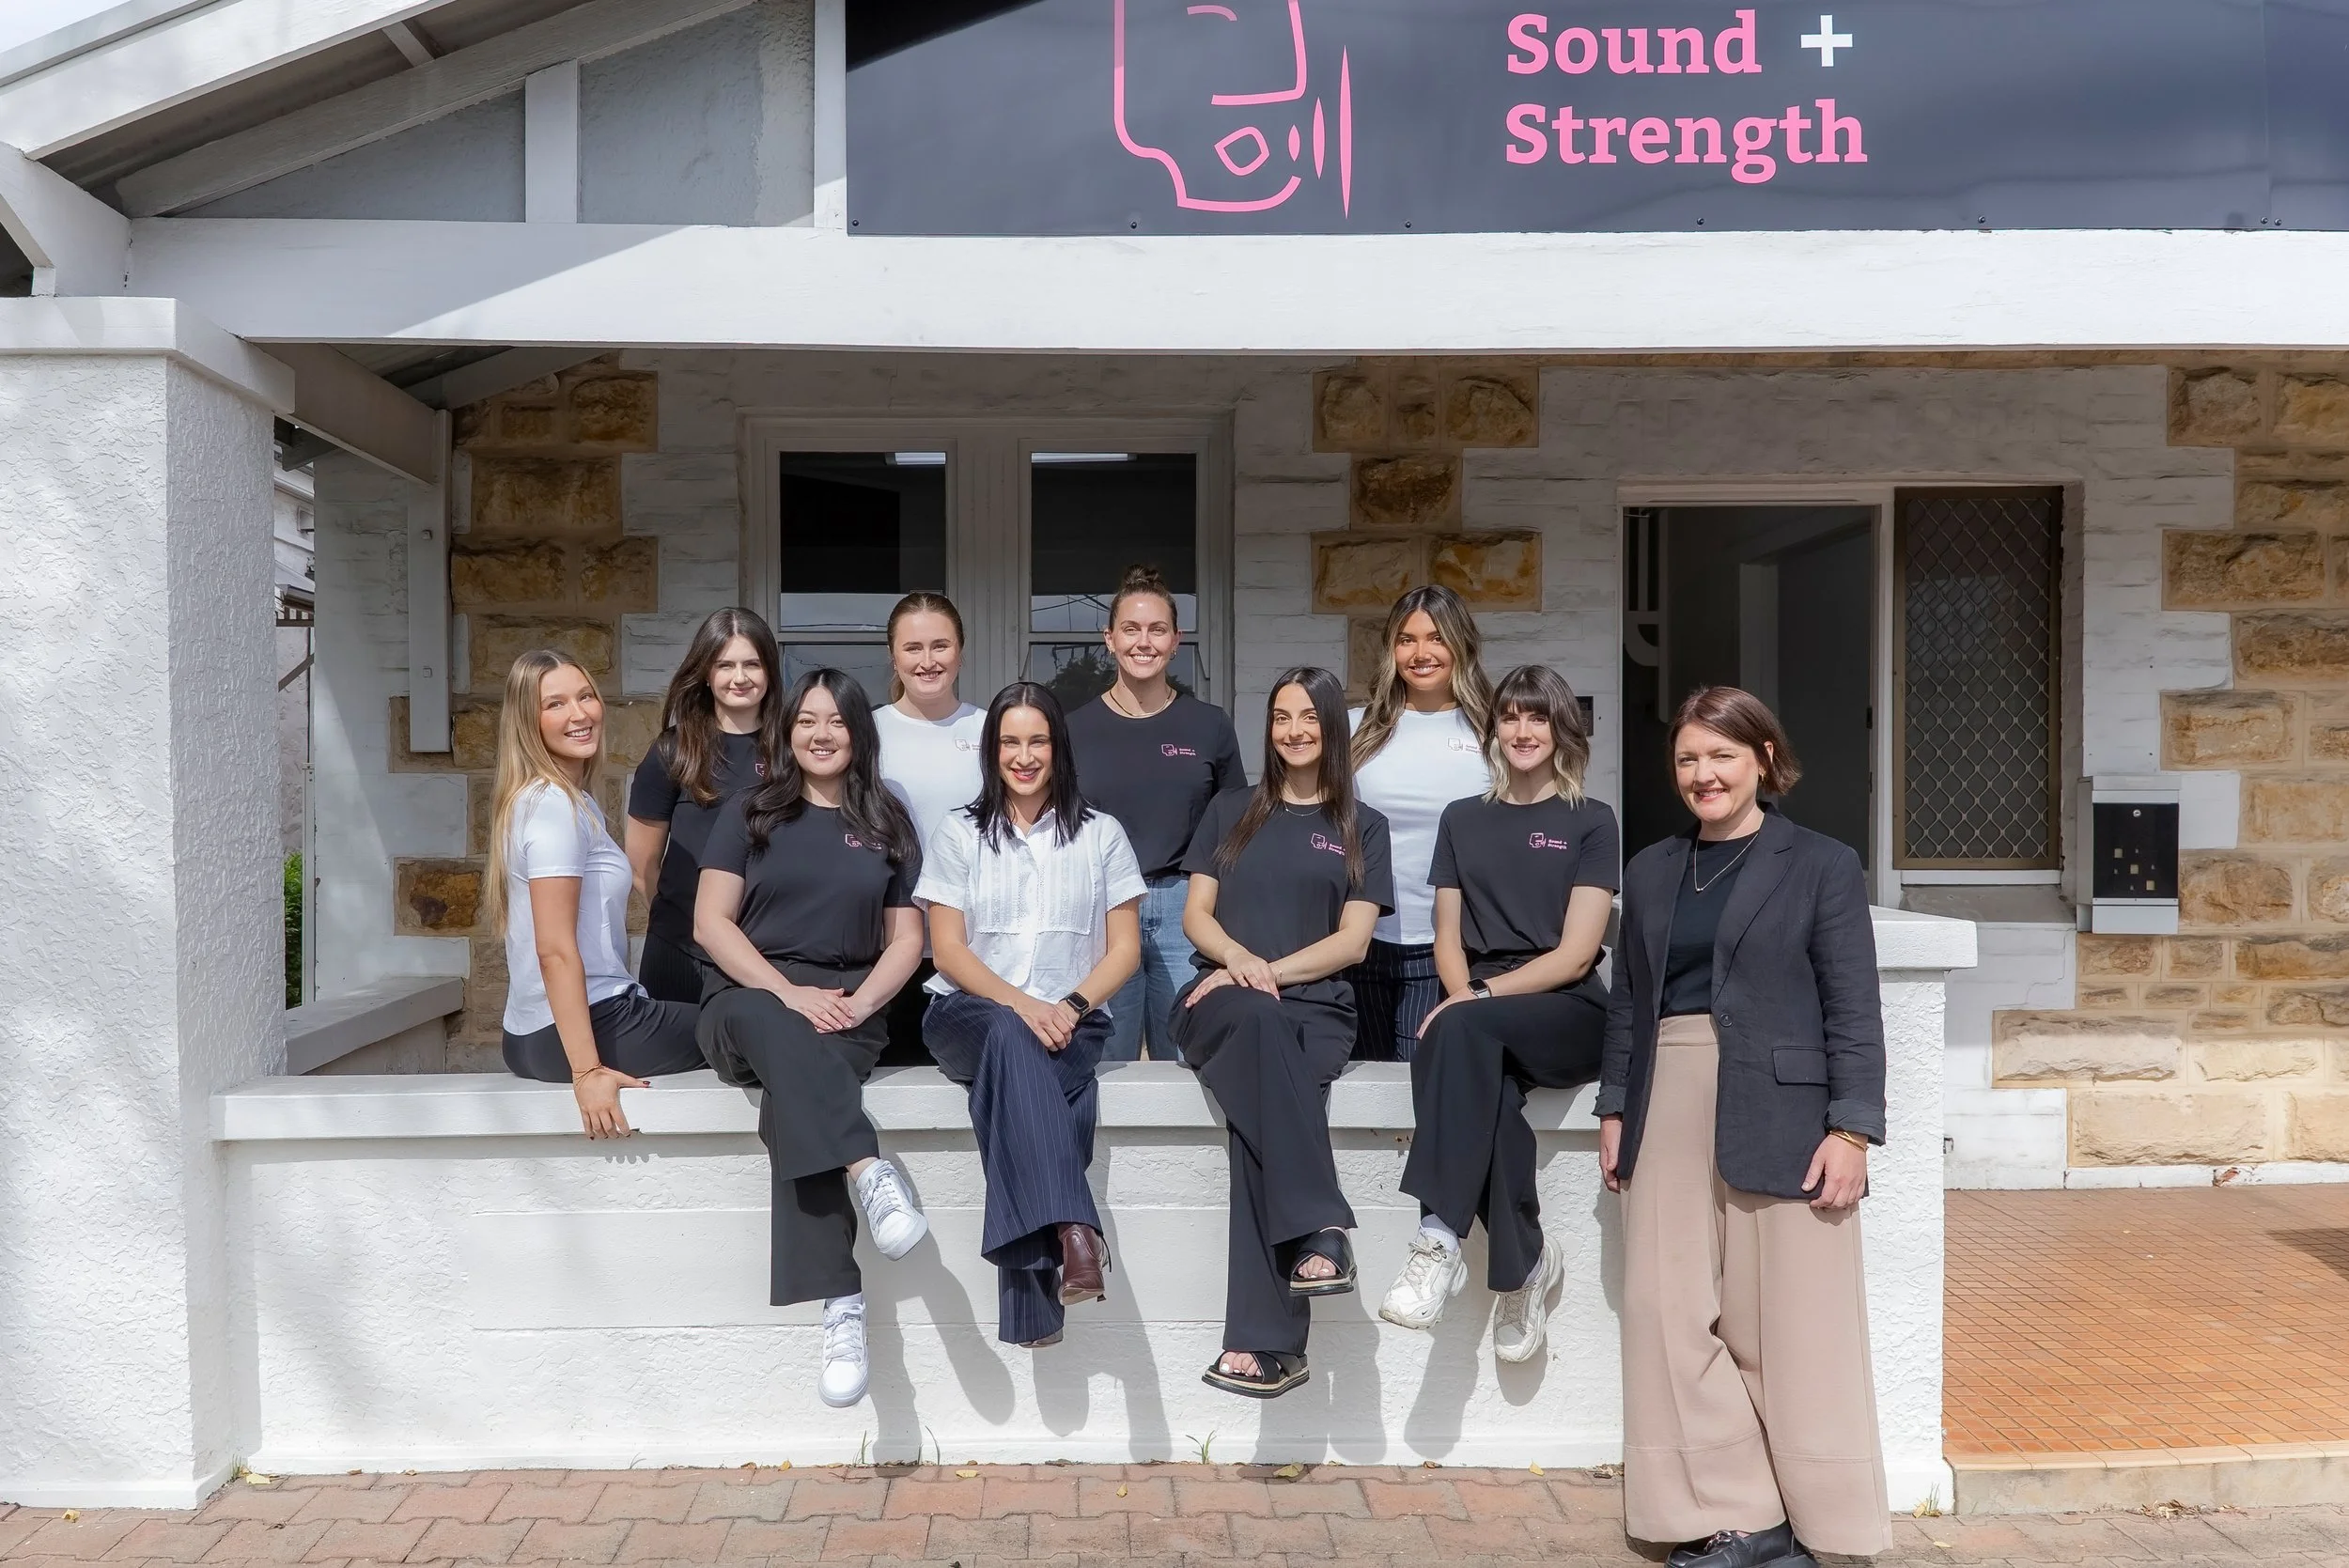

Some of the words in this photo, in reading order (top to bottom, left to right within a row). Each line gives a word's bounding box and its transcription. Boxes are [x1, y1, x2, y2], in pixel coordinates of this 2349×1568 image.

[1507, 8, 1763, 74] Sound
[1800, 14, 1853, 68] +
[1505, 98, 1868, 184] Strength
